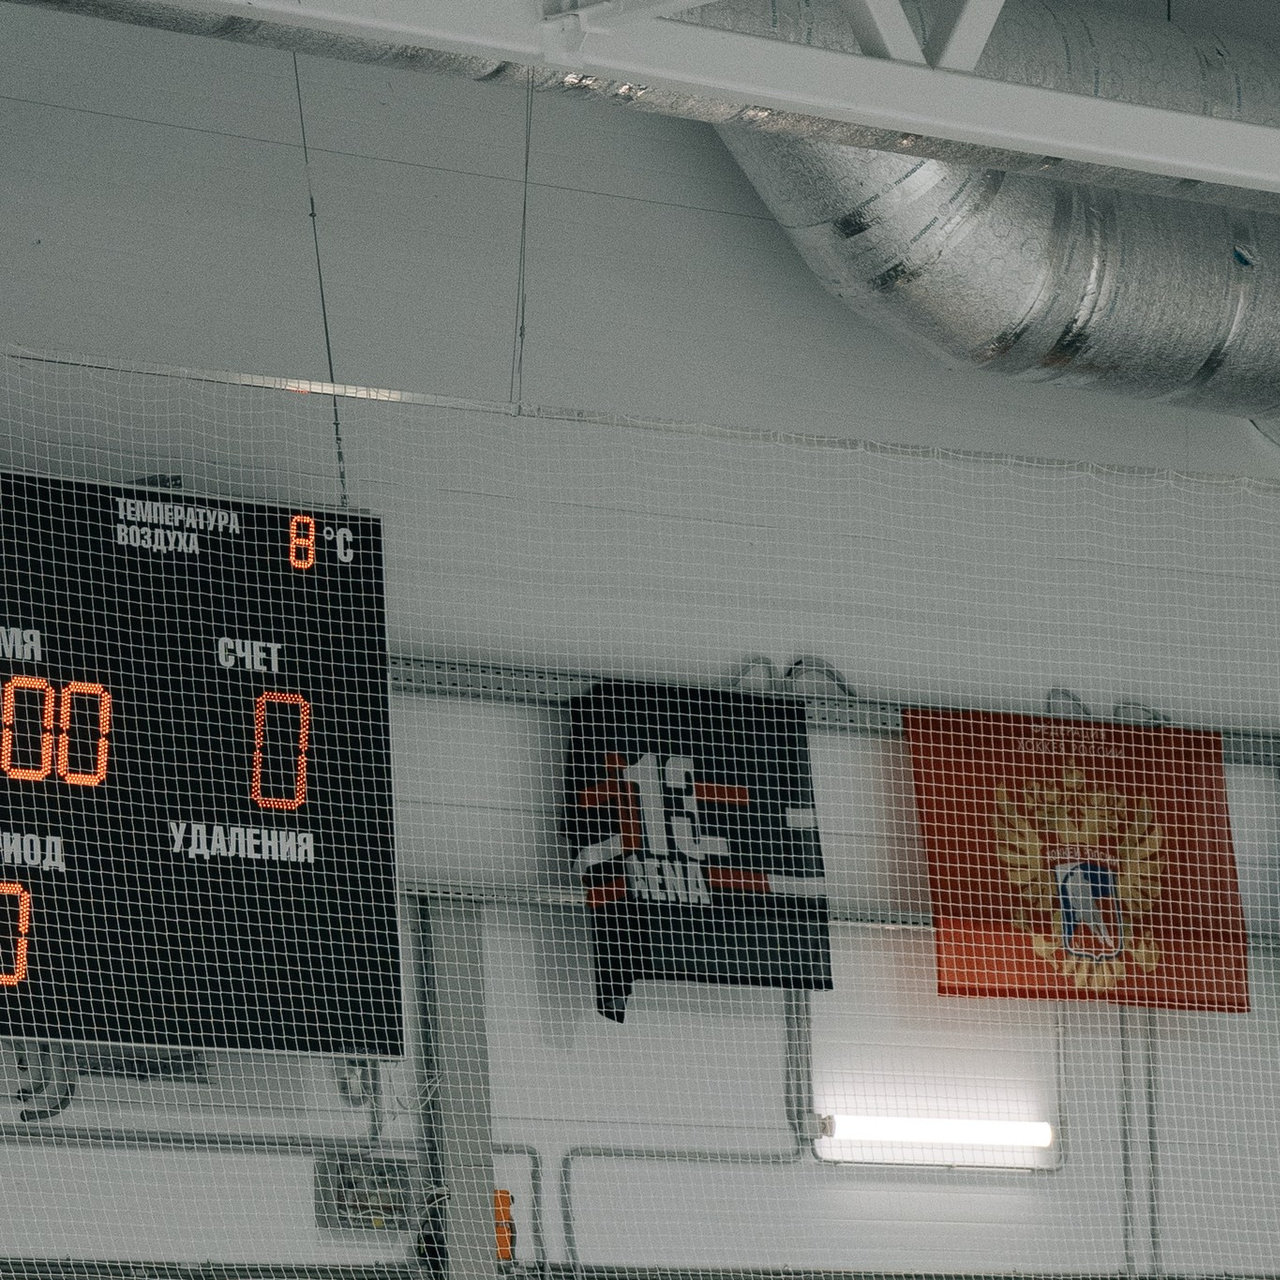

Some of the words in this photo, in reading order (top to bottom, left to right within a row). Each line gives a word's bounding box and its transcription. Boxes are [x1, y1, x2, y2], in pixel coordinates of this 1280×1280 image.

[115, 497, 241, 534] ТЕМПЕРАТУРА
[116, 523, 200, 554] ВОЗДУХА
[289, 514, 316, 569] 8
[217, 636, 282, 674] СЧЕТ
[251, 691, 311, 809] 0
[0, 832, 66, 872] ИОД
[169, 821, 315, 863] УДАЛЕНИЯ
